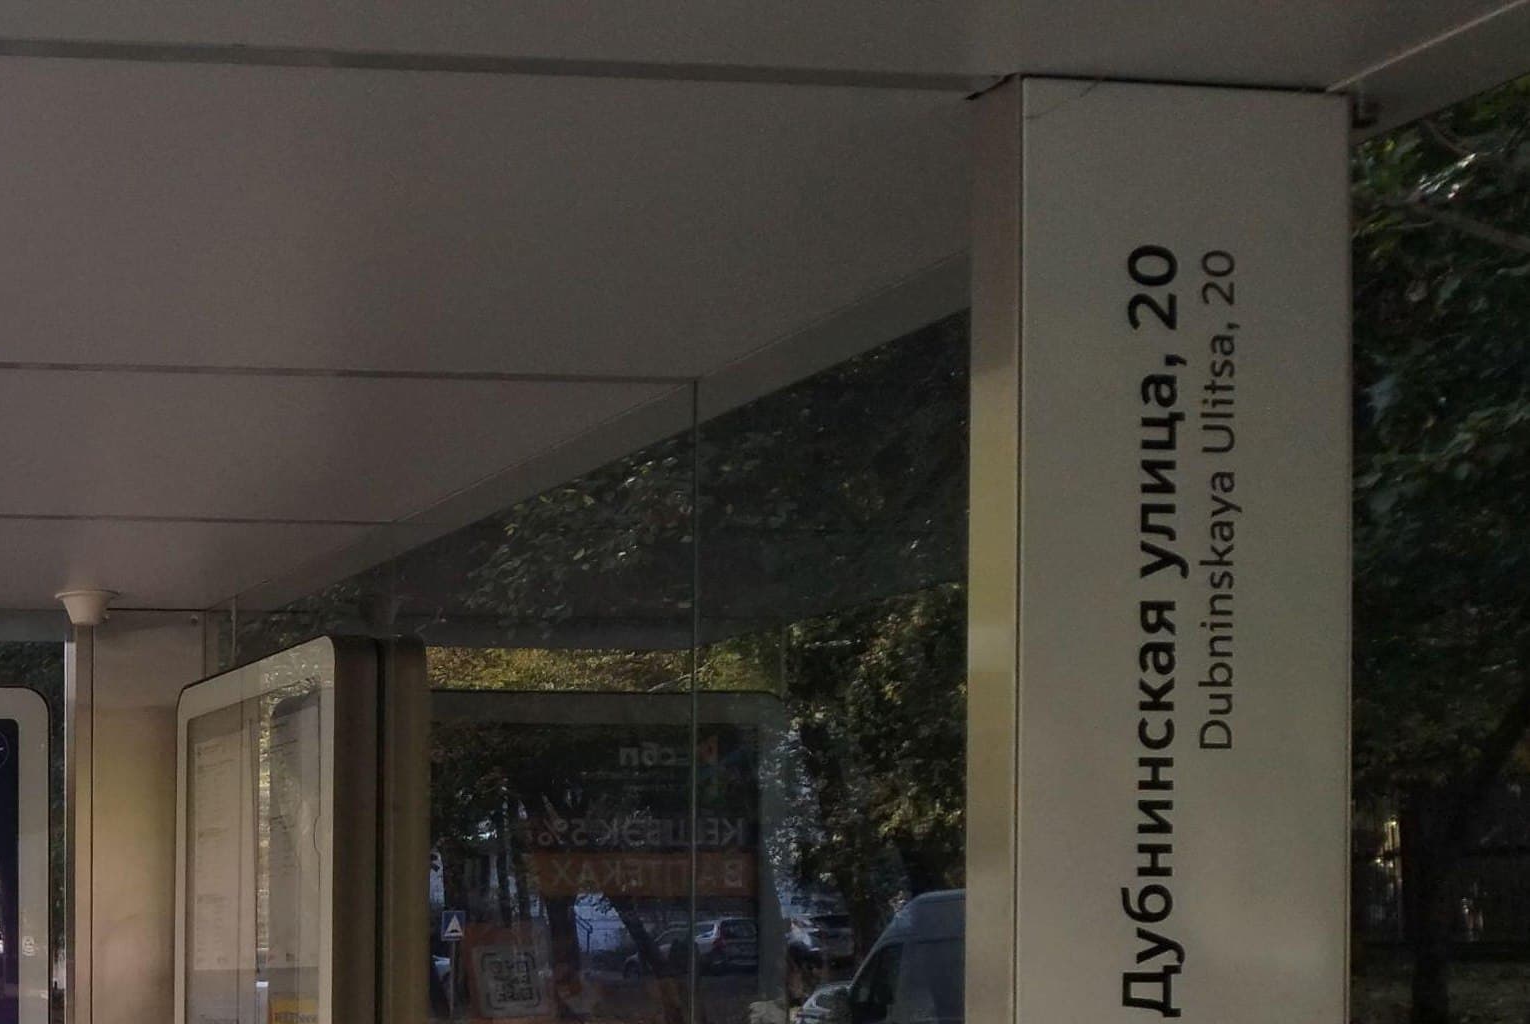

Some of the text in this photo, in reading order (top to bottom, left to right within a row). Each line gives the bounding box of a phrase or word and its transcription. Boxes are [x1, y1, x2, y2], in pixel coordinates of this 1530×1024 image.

[1121, 243, 1188, 1020] Дубнинская улица, 20
[1198, 248, 1242, 751] Dubninskaya Ulitsa, 20
